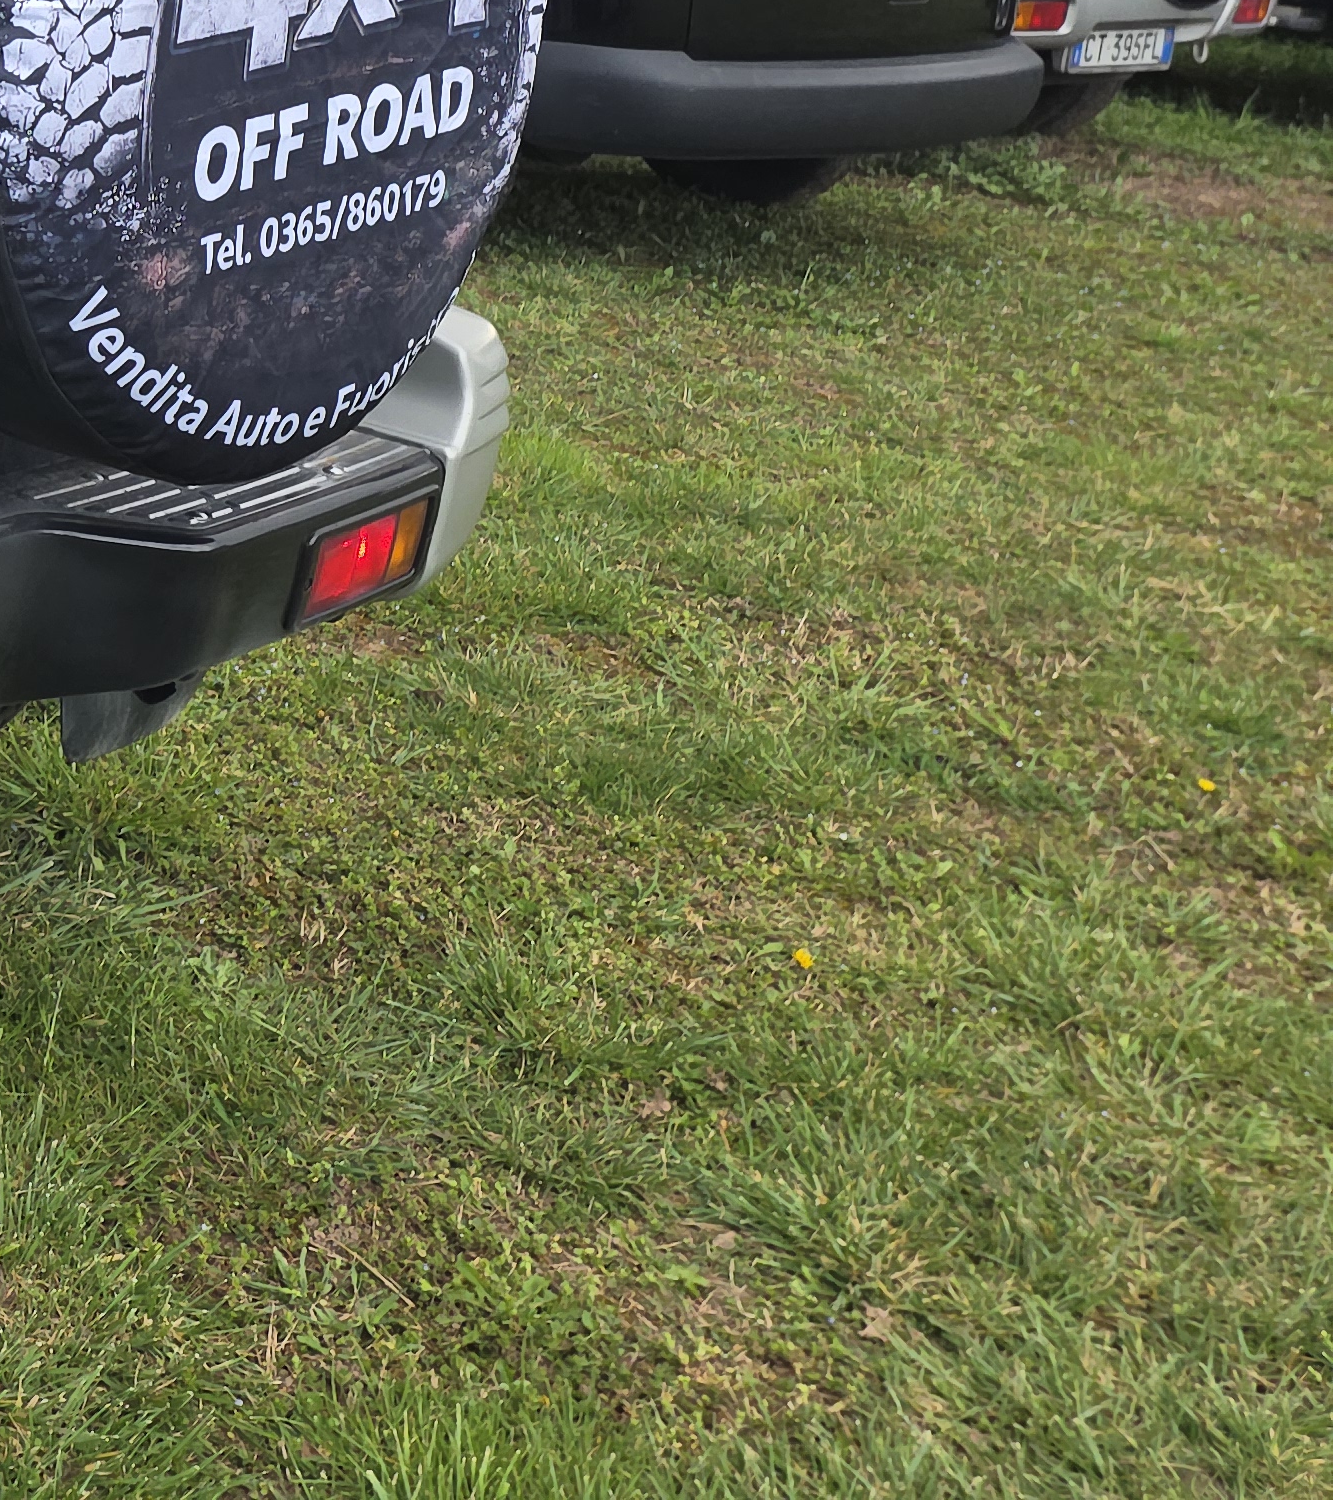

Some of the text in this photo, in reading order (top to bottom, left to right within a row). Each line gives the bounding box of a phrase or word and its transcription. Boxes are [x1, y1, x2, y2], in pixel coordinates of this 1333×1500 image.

[194, 66, 473, 201] OFF ROAD
[200, 169, 446, 275] Tel. 0365/860179
[68, 285, 209, 435] Vendita
[203, 399, 300, 447] Auto
[303, 406, 326, 438] e
